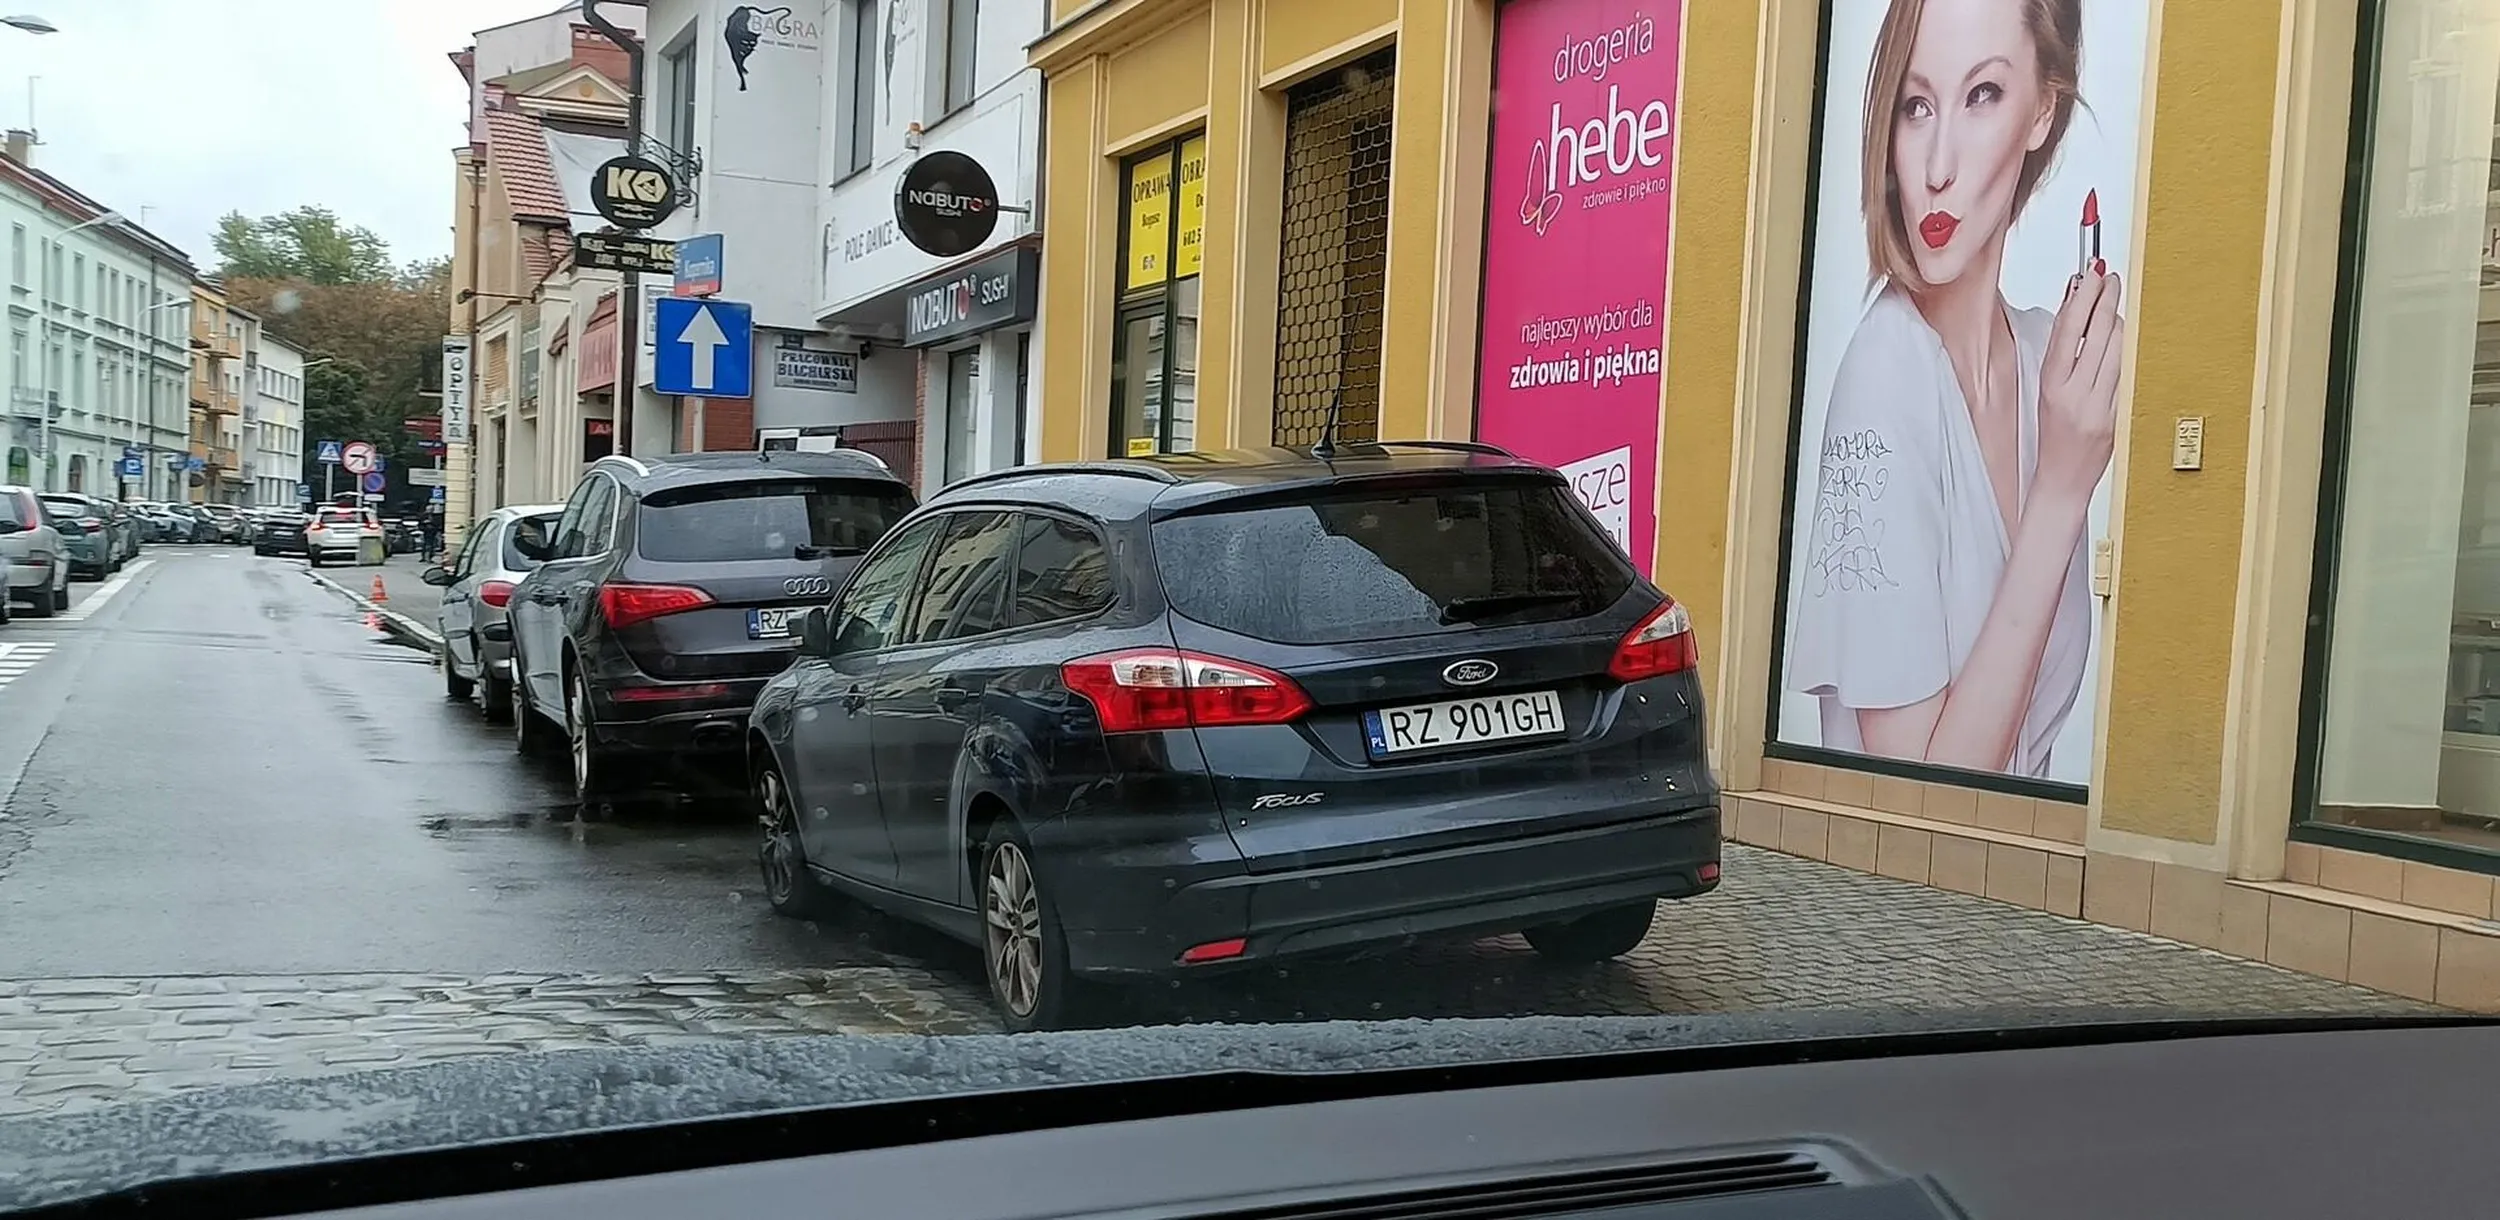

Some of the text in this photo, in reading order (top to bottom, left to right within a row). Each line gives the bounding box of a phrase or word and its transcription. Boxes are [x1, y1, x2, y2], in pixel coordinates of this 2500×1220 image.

[751, 13, 818, 40] BAGRA
[1554, 12, 1654, 82] drogeria
[1549, 84, 1669, 192] hebe
[1133, 172, 1172, 203] OPRAWA
[1583, 187, 1621, 209] zdrowie
[1629, 177, 1665, 201] piękno
[845, 219, 893, 263] POLE DANCE
[981, 274, 1010, 305] SUSHI
[1521, 299, 1653, 348] najlepszy wybór dla
[781, 352, 850, 367] PRACOWNIA
[1510, 343, 1660, 389] zdrowia i piękna
[1571, 463, 1626, 511] sze
[1457, 665, 1487, 680] Ford
[1372, 695, 1556, 747] PL RZ 901GH
